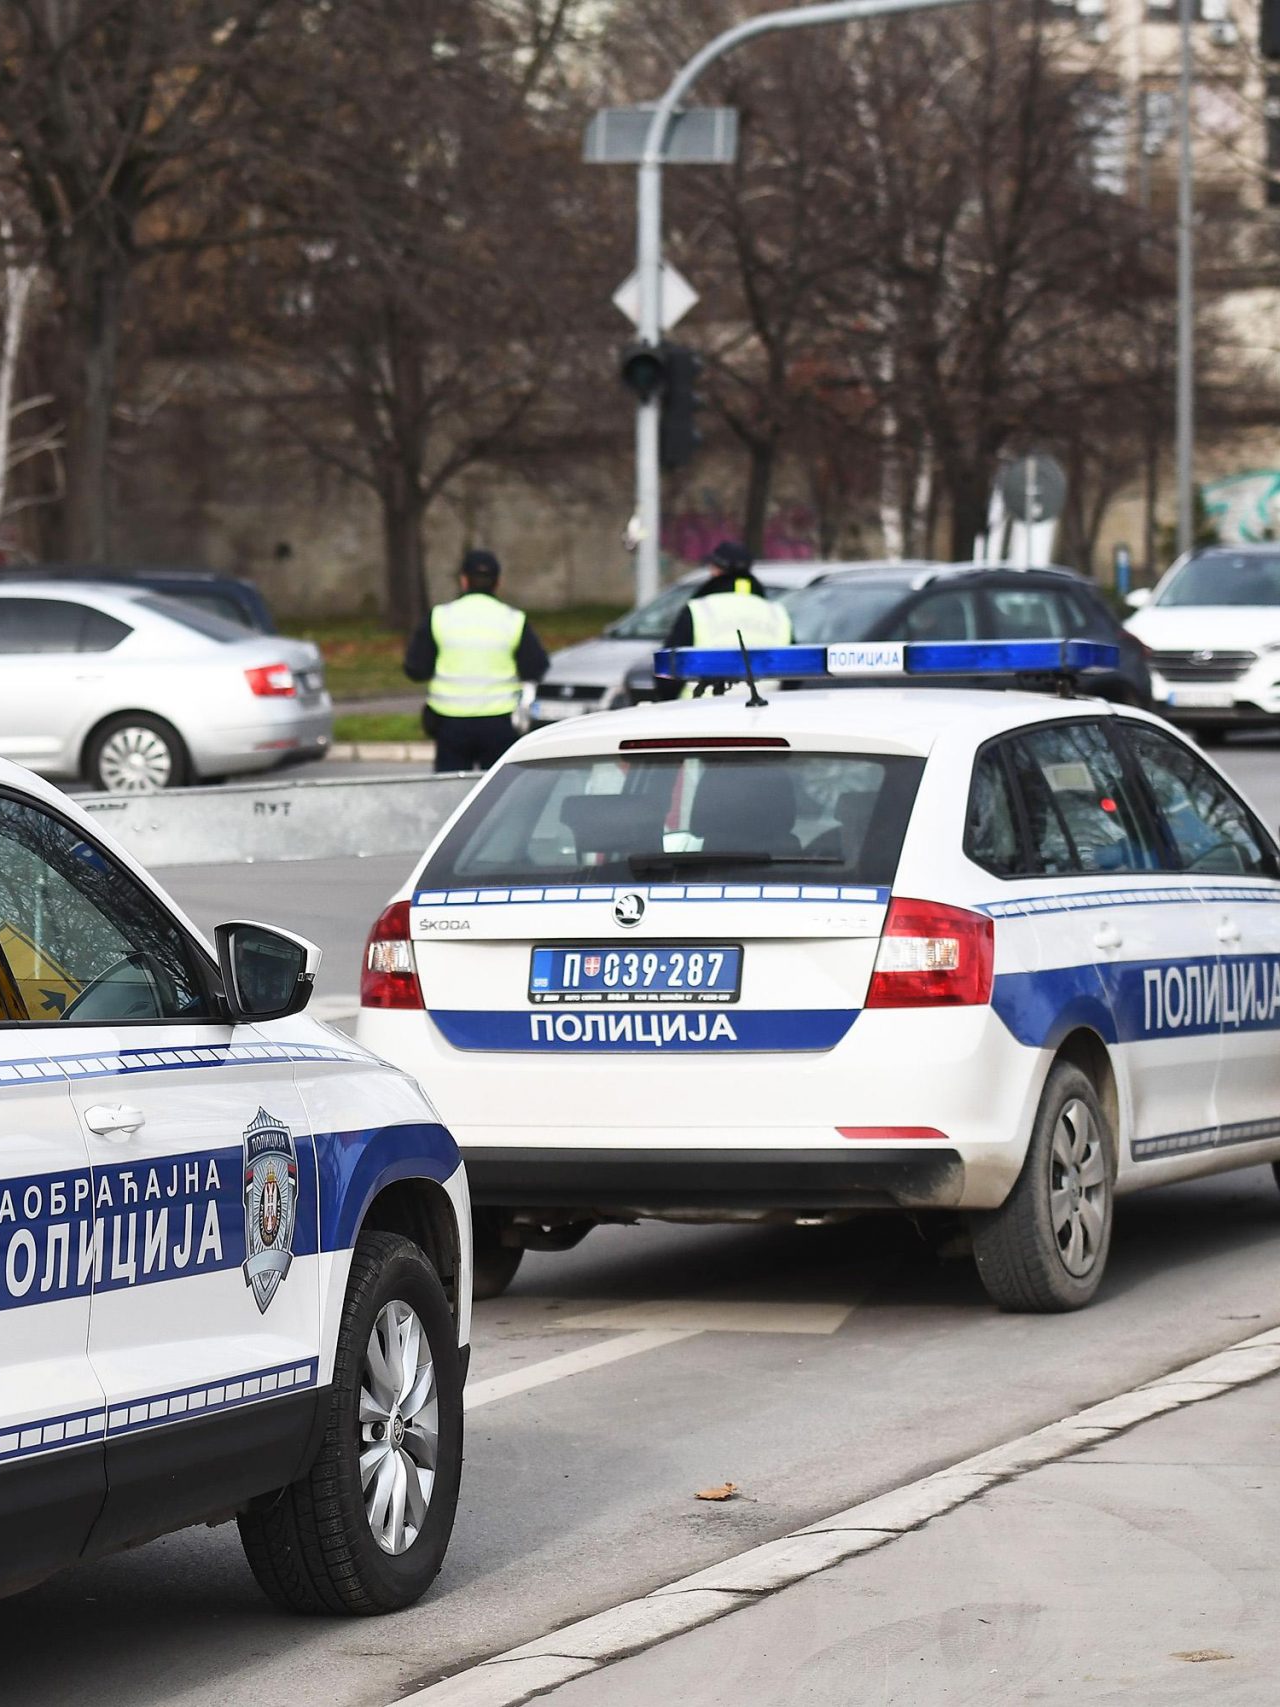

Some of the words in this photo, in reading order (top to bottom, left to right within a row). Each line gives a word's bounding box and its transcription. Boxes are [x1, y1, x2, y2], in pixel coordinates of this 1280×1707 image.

[828, 650, 900, 668] ПОЛИЦИЈА
[419, 918, 471, 931] ŠKODA
[562, 953, 581, 987] П
[1143, 962, 1280, 1031] ПОЛИЦИЈА
[529, 1013, 738, 1047] ПОЛИЦИЈА
[251, 1132, 286, 1154] ПОЛИЦИЈА
